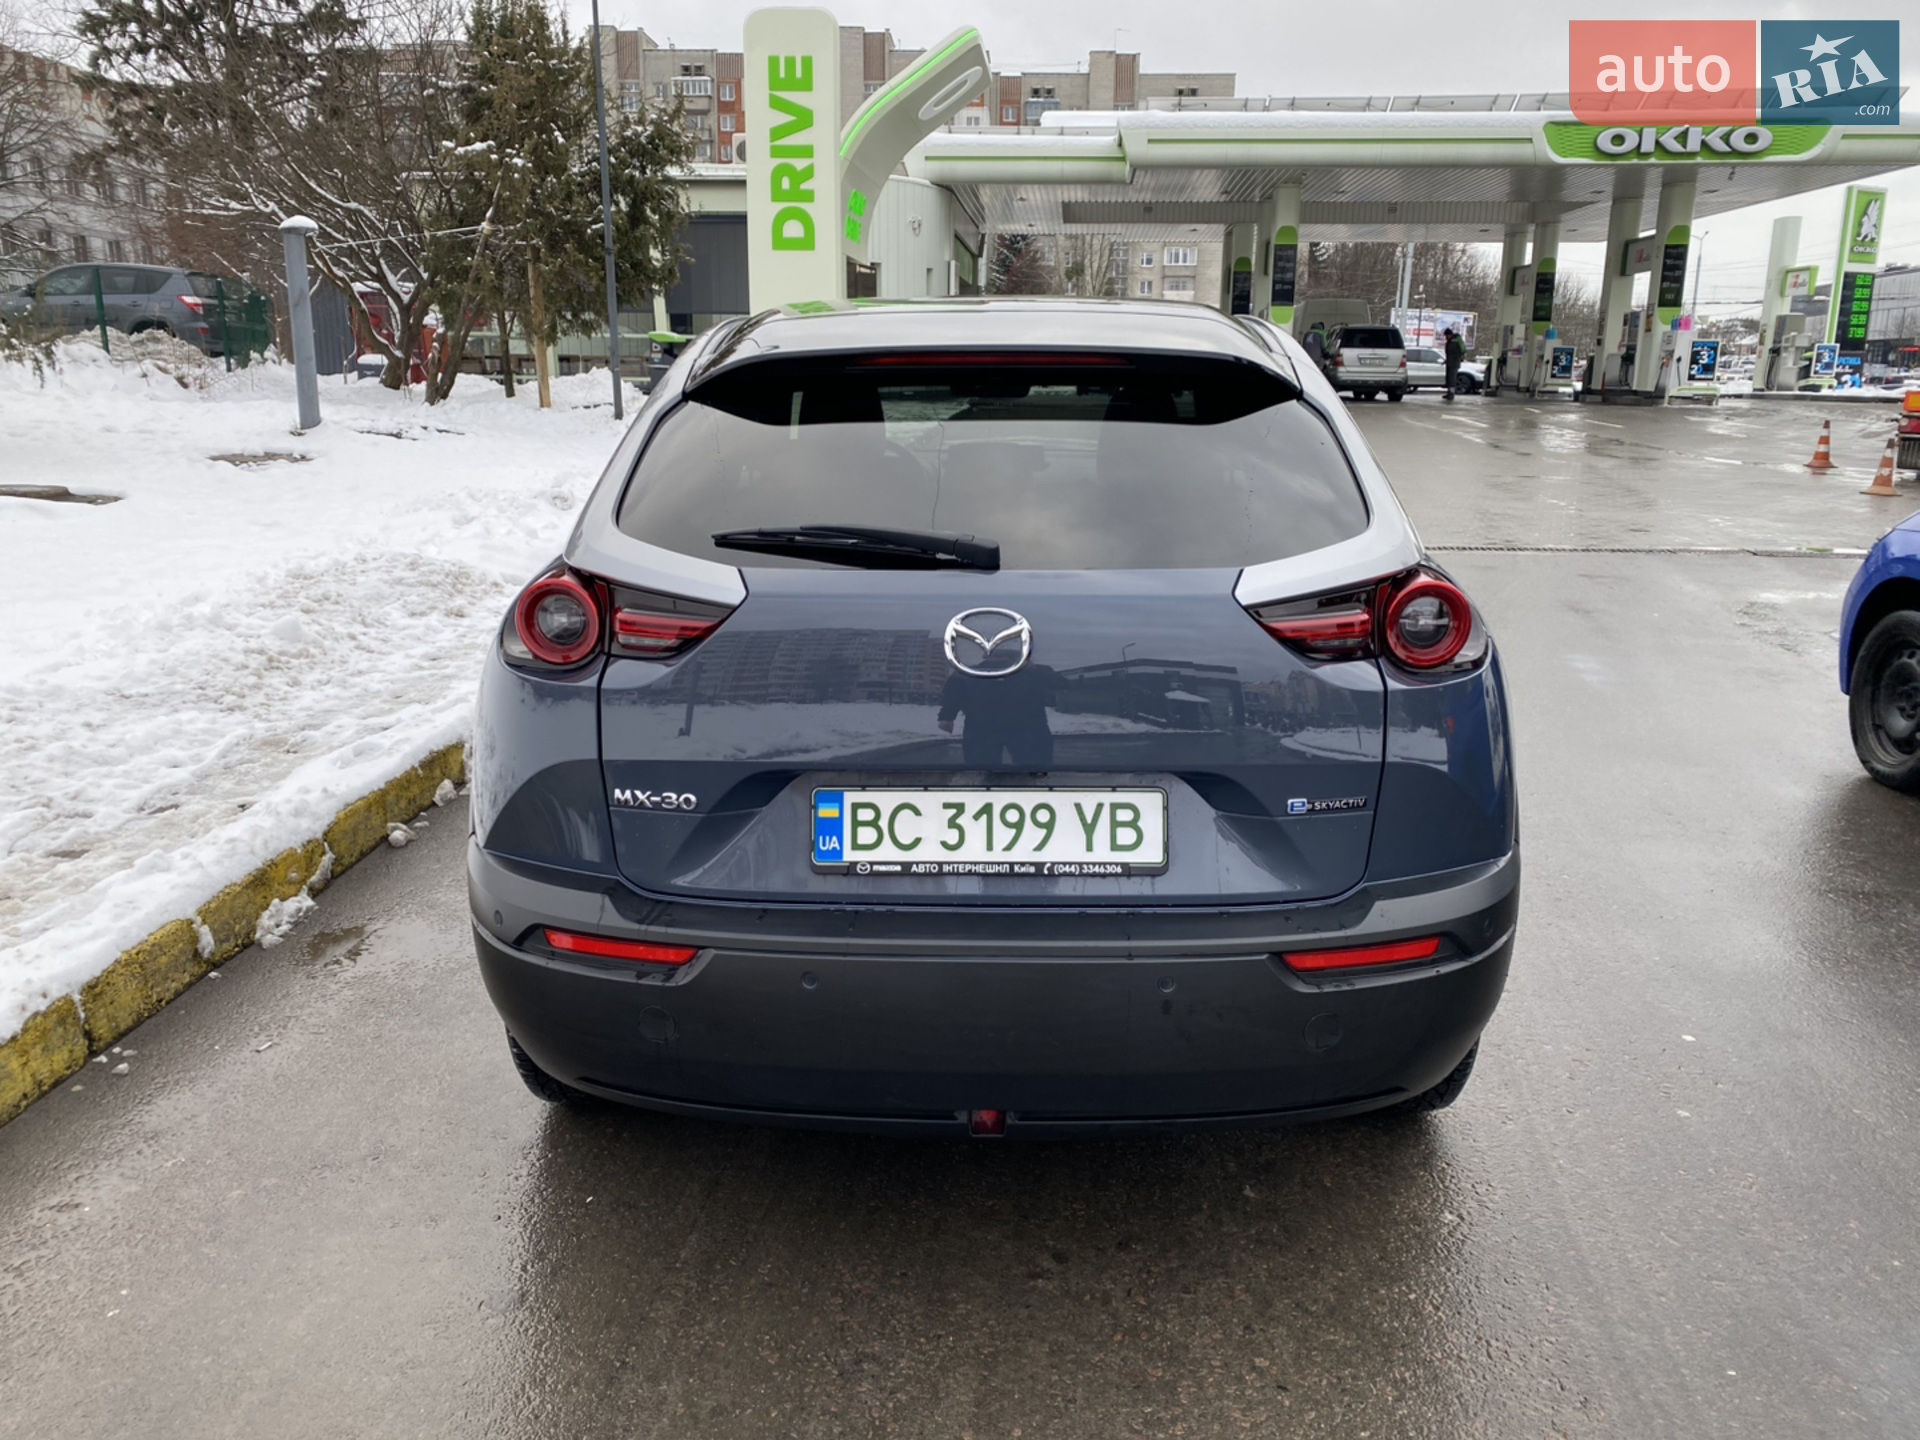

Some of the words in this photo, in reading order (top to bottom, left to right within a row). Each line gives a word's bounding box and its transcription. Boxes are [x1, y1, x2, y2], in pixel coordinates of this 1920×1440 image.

[767, 55, 816, 251] DRIVE
[1595, 125, 1774, 155] OKKO
[614, 788, 697, 810] MX-30
[850, 802, 923, 851] BC
[939, 802, 1057, 852] 3199
[1073, 802, 1144, 852] YB
[818, 836, 841, 850] UA
[910, 863, 938, 873] АВТО
[942, 863, 1010, 873] ІНТЕРНЕШНЛ
[1053, 864, 1080, 875] (044)
[1081, 864, 1122, 874] 3346306
